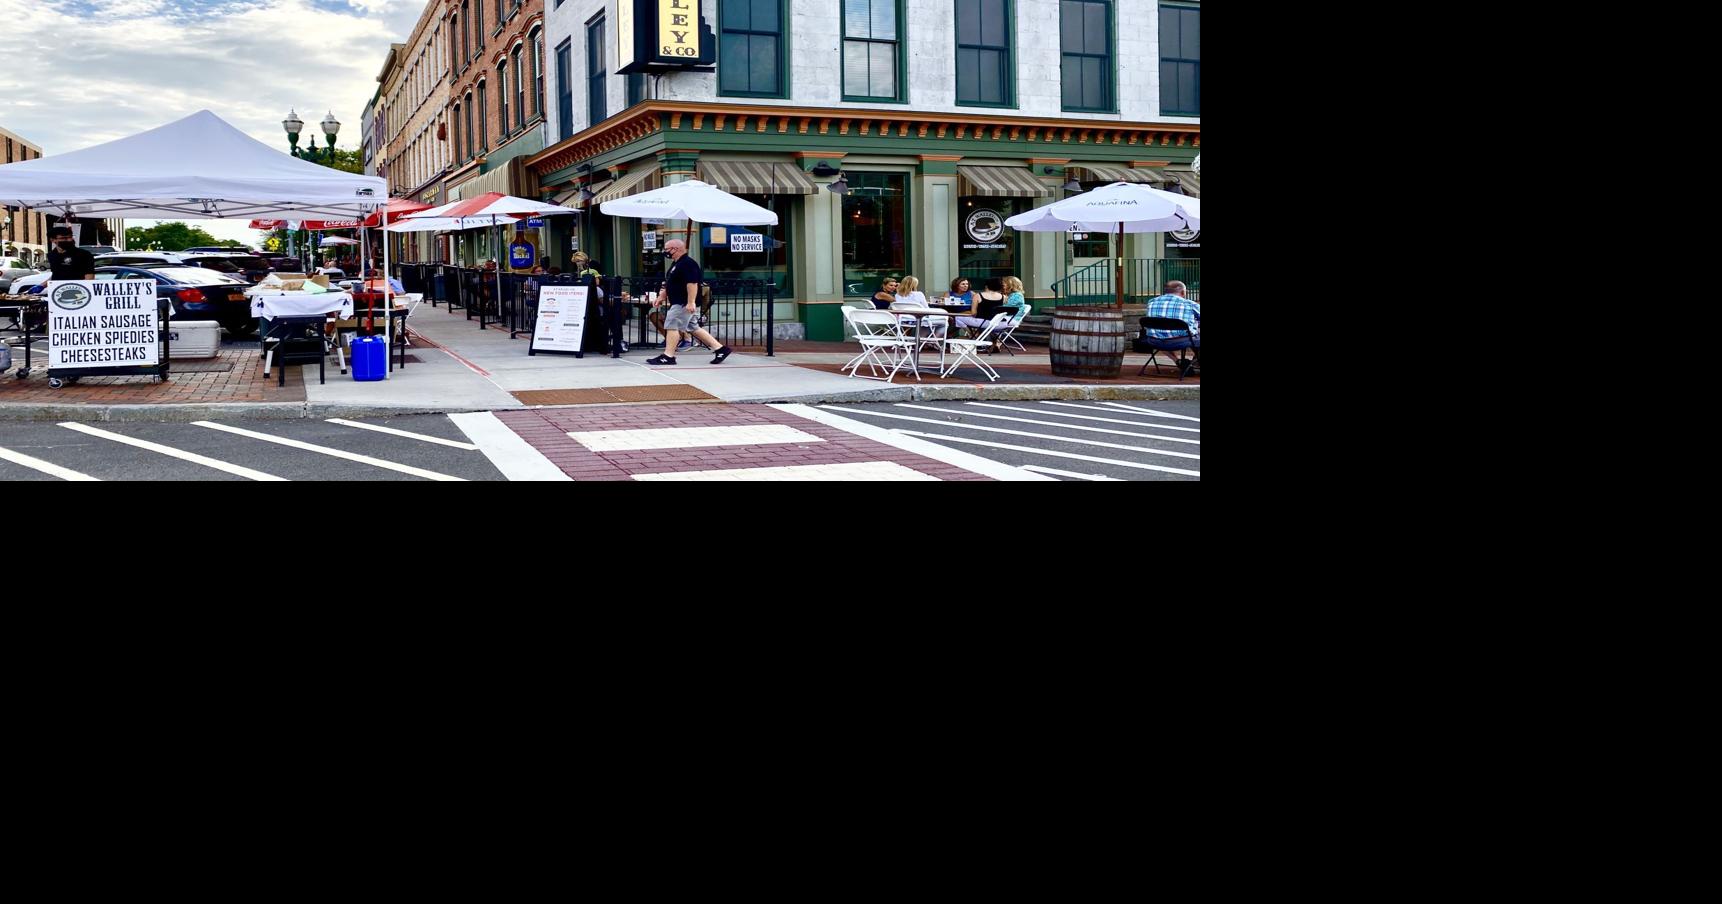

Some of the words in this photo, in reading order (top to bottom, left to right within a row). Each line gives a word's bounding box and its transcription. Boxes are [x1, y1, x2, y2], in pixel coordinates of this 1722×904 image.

[662, 46, 672, 55] &
[742, 235, 761, 243] MASKS
[740, 243, 762, 251] SERVICE
[92, 282, 152, 296] WALLEY'S
[105, 296, 141, 310] GRILL
[54, 315, 97, 330] ITALIAN
[101, 314, 152, 329] SAUSAGE
[52, 332, 101, 347] CHICKEN
[105, 330, 155, 345] SPIEDIES
[61, 346, 146, 363] CHEESESTEAKS
